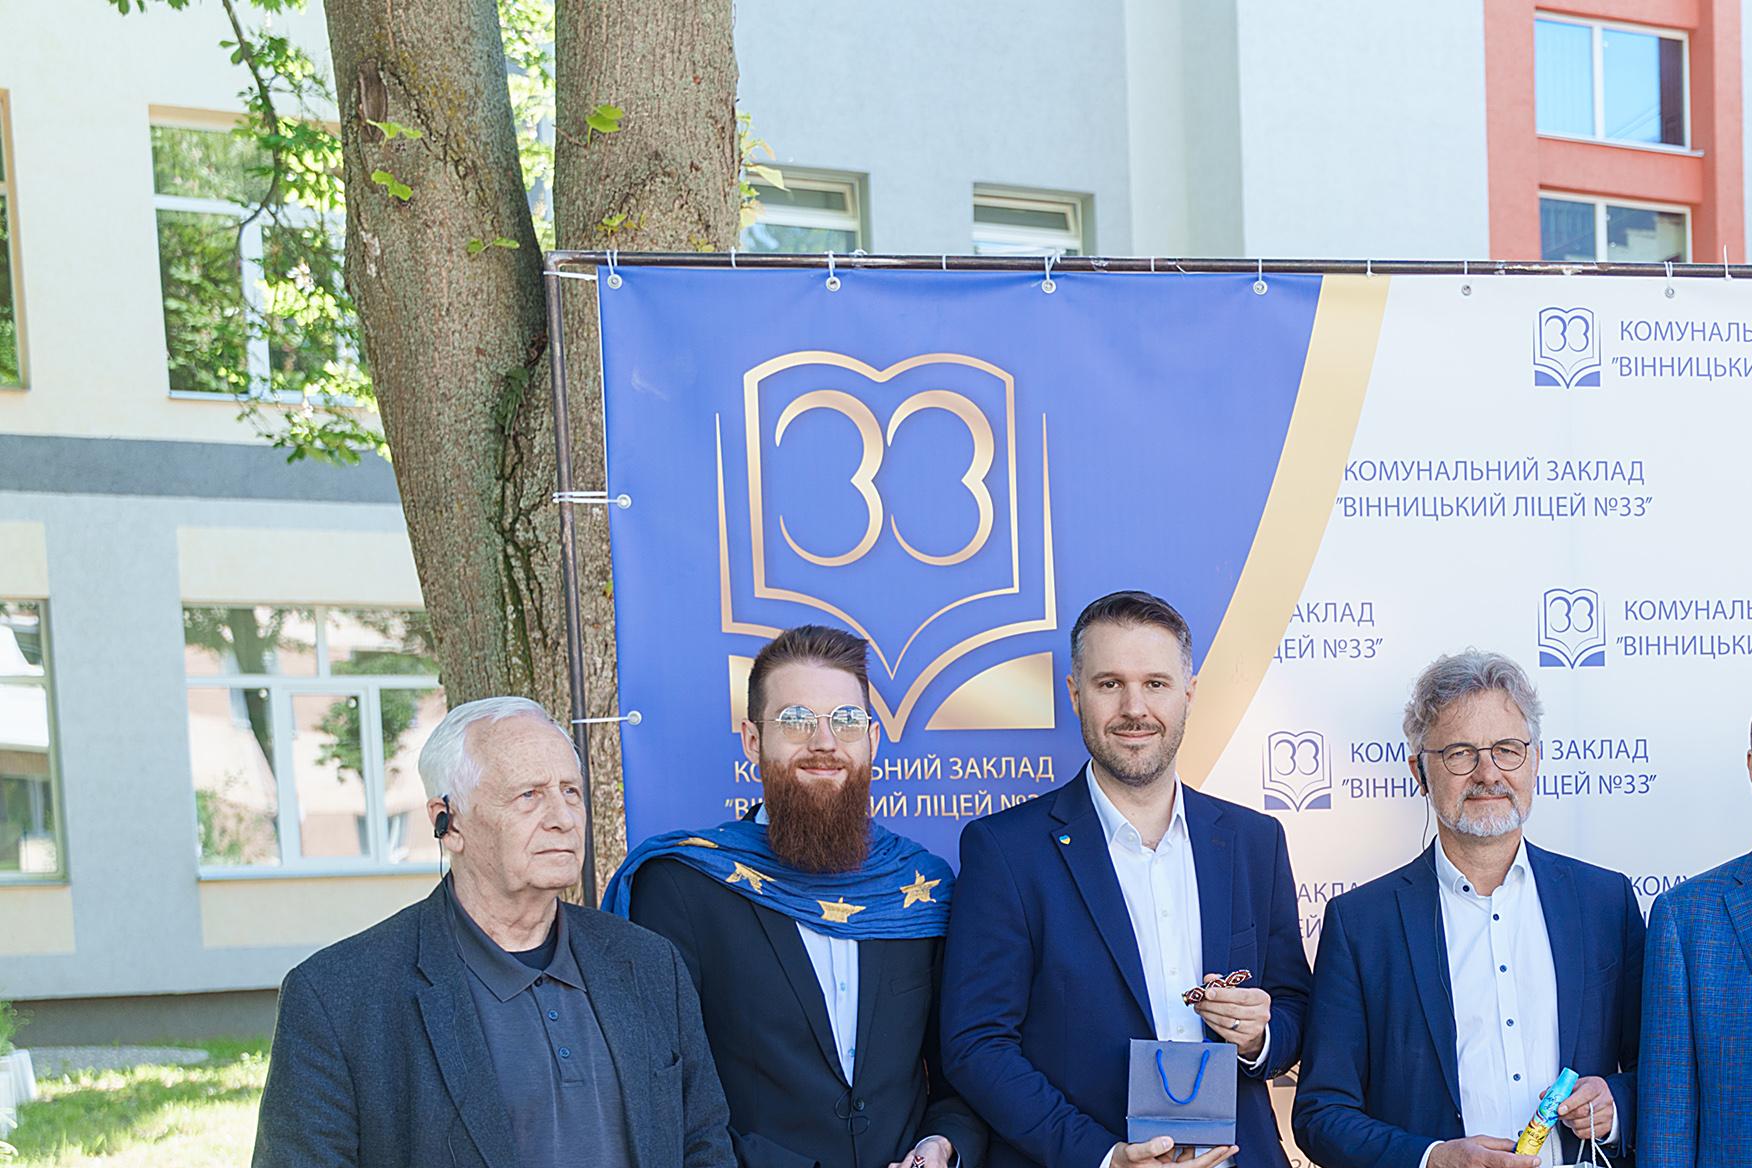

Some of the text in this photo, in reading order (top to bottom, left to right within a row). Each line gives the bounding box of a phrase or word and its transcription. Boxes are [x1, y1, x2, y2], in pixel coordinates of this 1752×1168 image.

[775, 389, 995, 566] 33
[1344, 457, 1644, 485] КОМУНАЛЬНИЙ ЗАКЛАД
[1335, 492, 1653, 521] "ВІННИЦЬКИЙ ЛІЦЕЙ №33"
[1290, 602, 1374, 627] АКЛАД
[1324, 638, 1383, 658] №33"
[1552, 739, 1648, 763] ЗАКЛАД
[949, 757, 1054, 783] ЗАКЛАД
[1342, 771, 1657, 799] "ВІННИ ІЦЕЙ №33"
[914, 790, 992, 820] ЛІЦЕЙ
